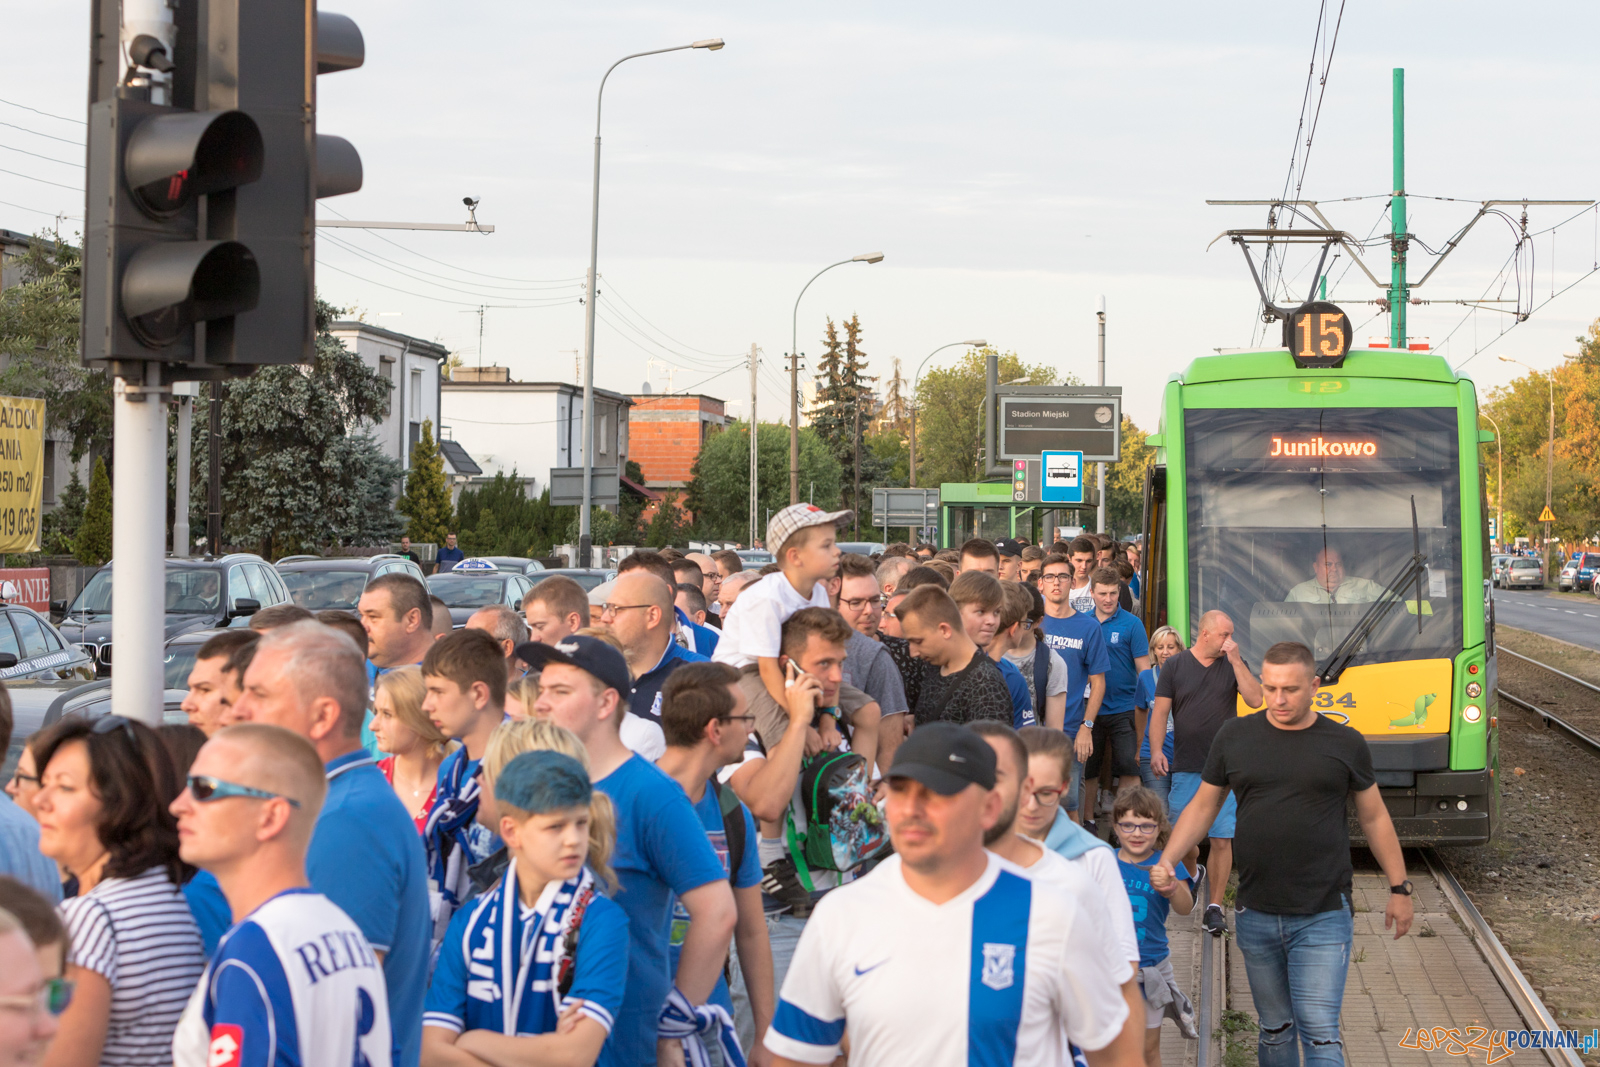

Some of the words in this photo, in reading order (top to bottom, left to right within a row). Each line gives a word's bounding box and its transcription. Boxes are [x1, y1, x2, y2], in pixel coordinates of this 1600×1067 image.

[1297, 313, 1344, 356] 15
[1011, 410, 1041, 418] Stadion
[1042, 410, 1070, 420] Miejski
[1271, 437, 1377, 456] Junikowo
[0, 471, 13, 493] 50
[0, 507, 15, 536] 19
[18, 507, 35, 535] 035
[1310, 691, 1357, 708] 34
